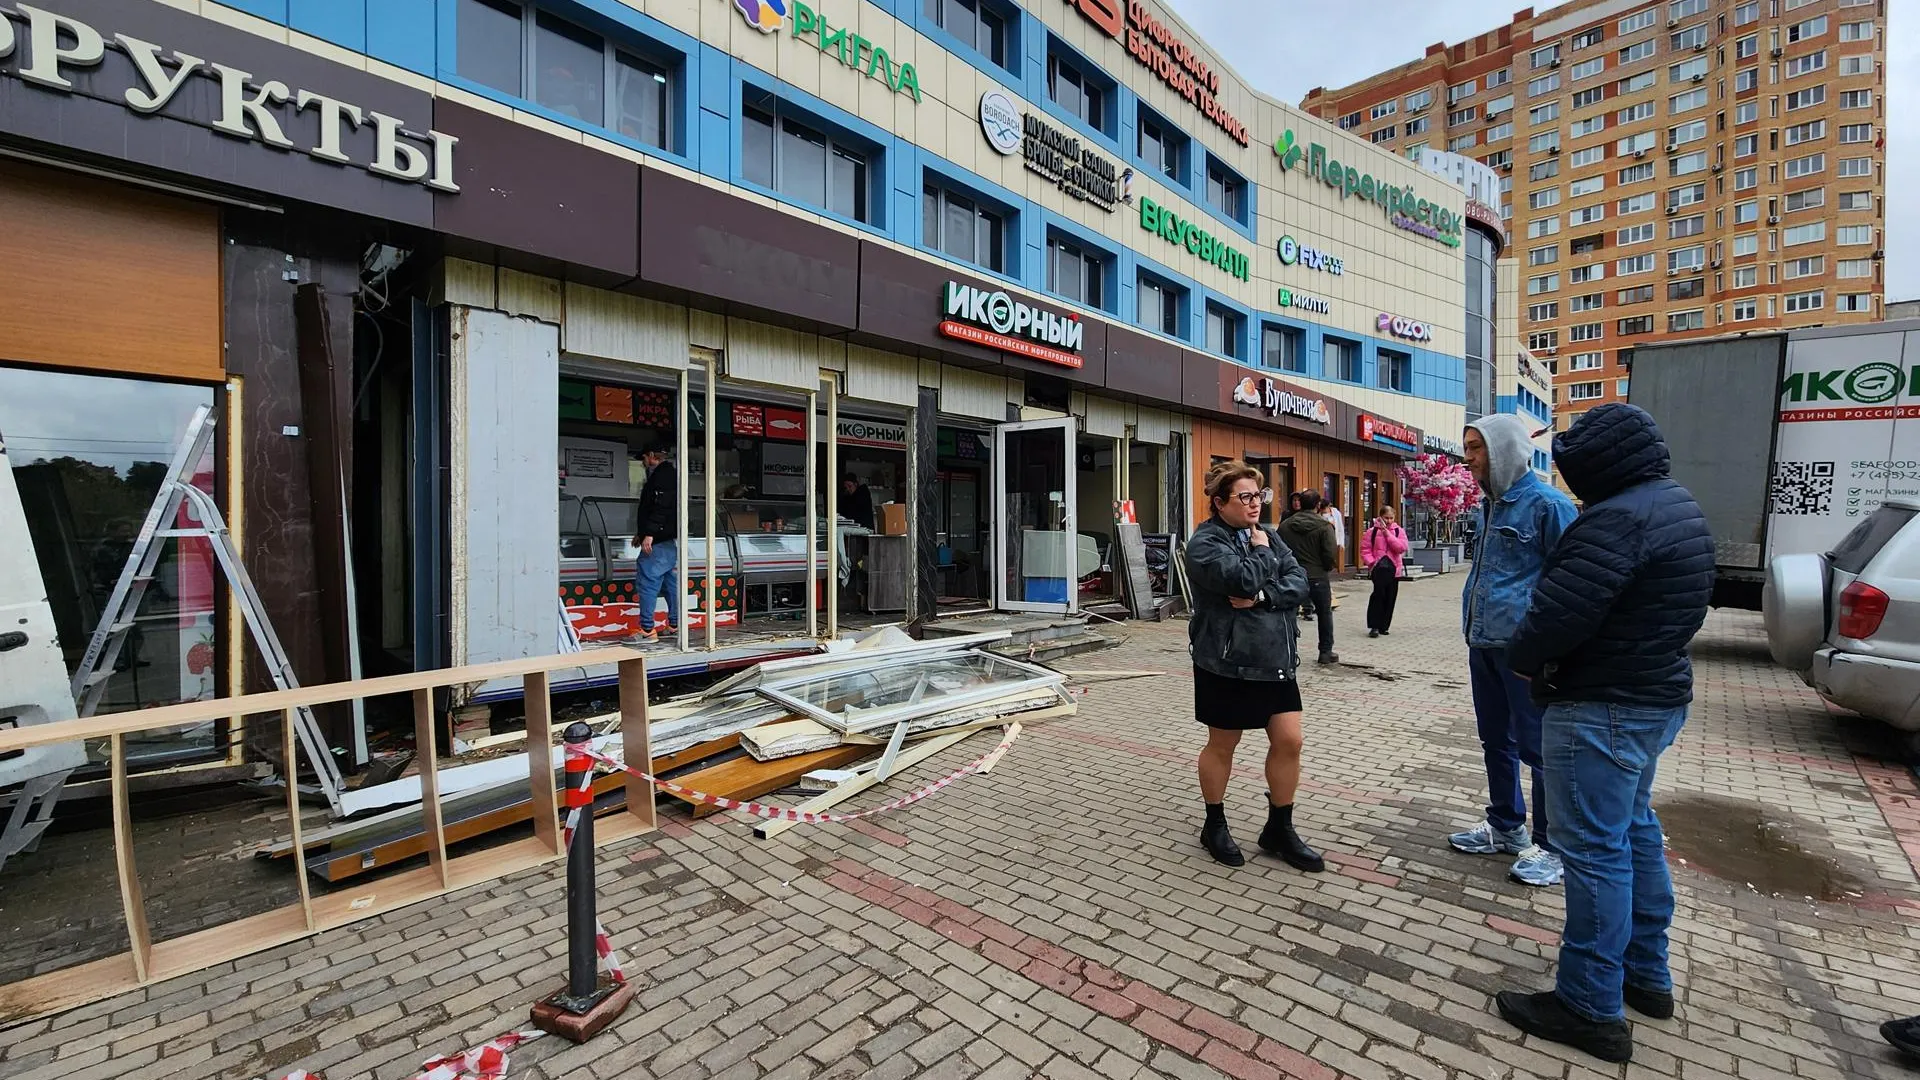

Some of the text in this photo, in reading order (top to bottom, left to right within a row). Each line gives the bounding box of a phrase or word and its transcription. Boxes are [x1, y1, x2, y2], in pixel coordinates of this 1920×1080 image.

[791, 0, 922, 104] РИГЛА
[1127, 0, 1208, 84] ЦИФРОВАЯ
[1206, 69, 1220, 95] И
[0, 2, 460, 193] РУКТЫ
[1126, 27, 1249, 148] БЫТОВАЯ ТЕХНИКА
[984, 103, 1020, 132] BORODACH
[1024, 112, 1116, 182] МУЖСКОЙ САЛОН
[1024, 135, 1064, 178] БРИТЬЯ
[1073, 164, 1116, 203] СТРИЖКИ
[1307, 142, 1462, 235] Перекрёсток
[1140, 196, 1249, 282] ВКУСВИЛЛ
[944, 280, 1083, 350] ИКОРНЫЙ
[1291, 293, 1330, 314] МИЛТИ
[947, 324, 982, 341] МАГАЗИН
[984, 333, 1029, 353] РОССИЙСКИХ
[1031, 347, 1082, 366] МОРЕПРОДУКТОВ
[1391, 316, 1432, 341] OZON
[1265, 377, 1317, 420] Булочная
[1781, 362, 1920, 404] ИКО
[639, 403, 669, 416] ИКРА
[735, 414, 762, 426] РЫБА
[1781, 411, 1837, 421] ГАЗИНЫ
[764, 463, 805, 473] ИКОРНЫЙ
[1869, 471, 1905, 481] (495)
